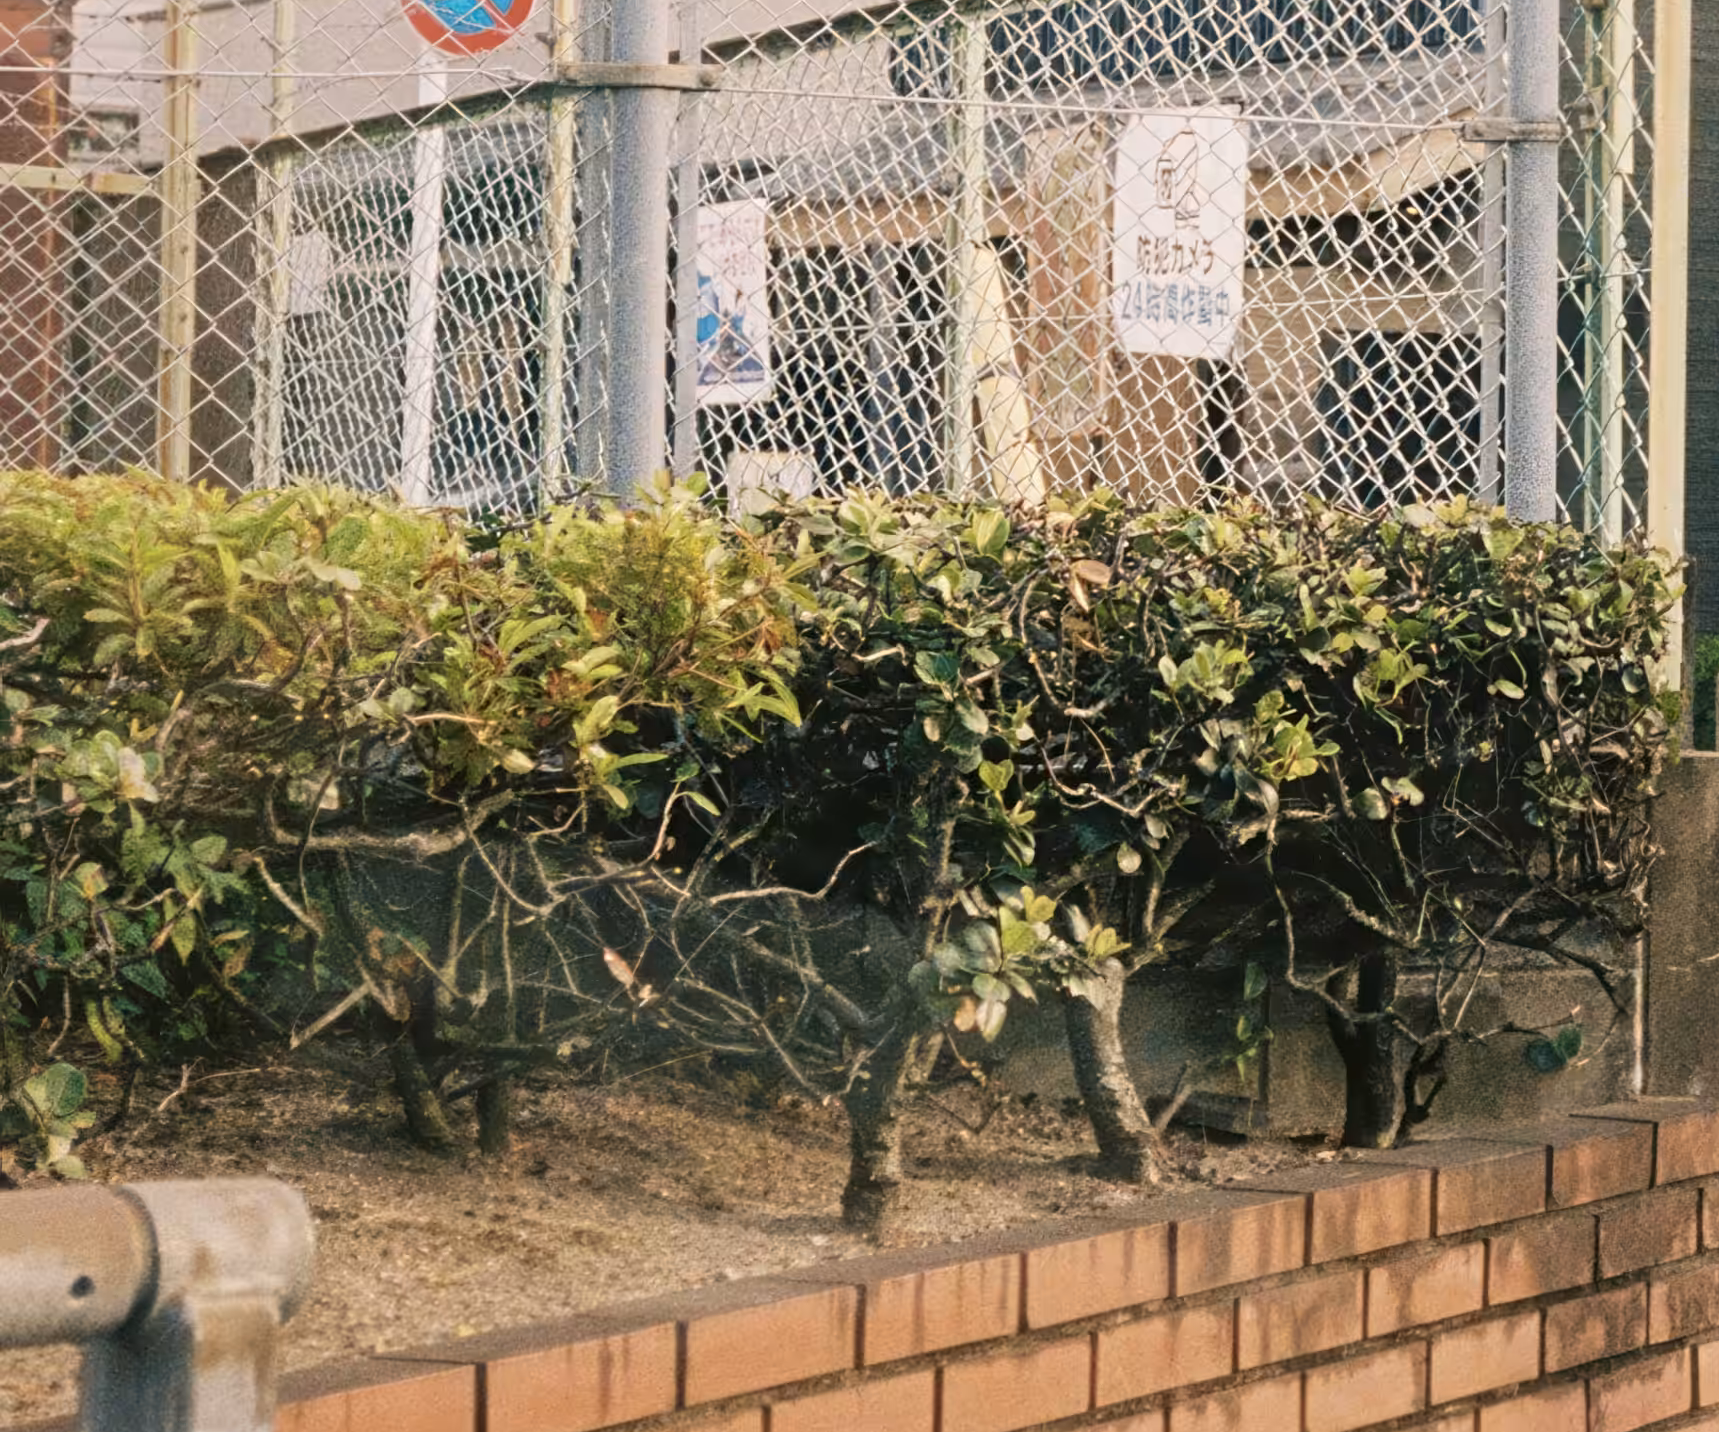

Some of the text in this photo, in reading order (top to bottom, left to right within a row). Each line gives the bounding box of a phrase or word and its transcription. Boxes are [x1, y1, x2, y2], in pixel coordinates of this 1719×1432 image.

[1137, 234, 1214, 275] 防犯カメラ
